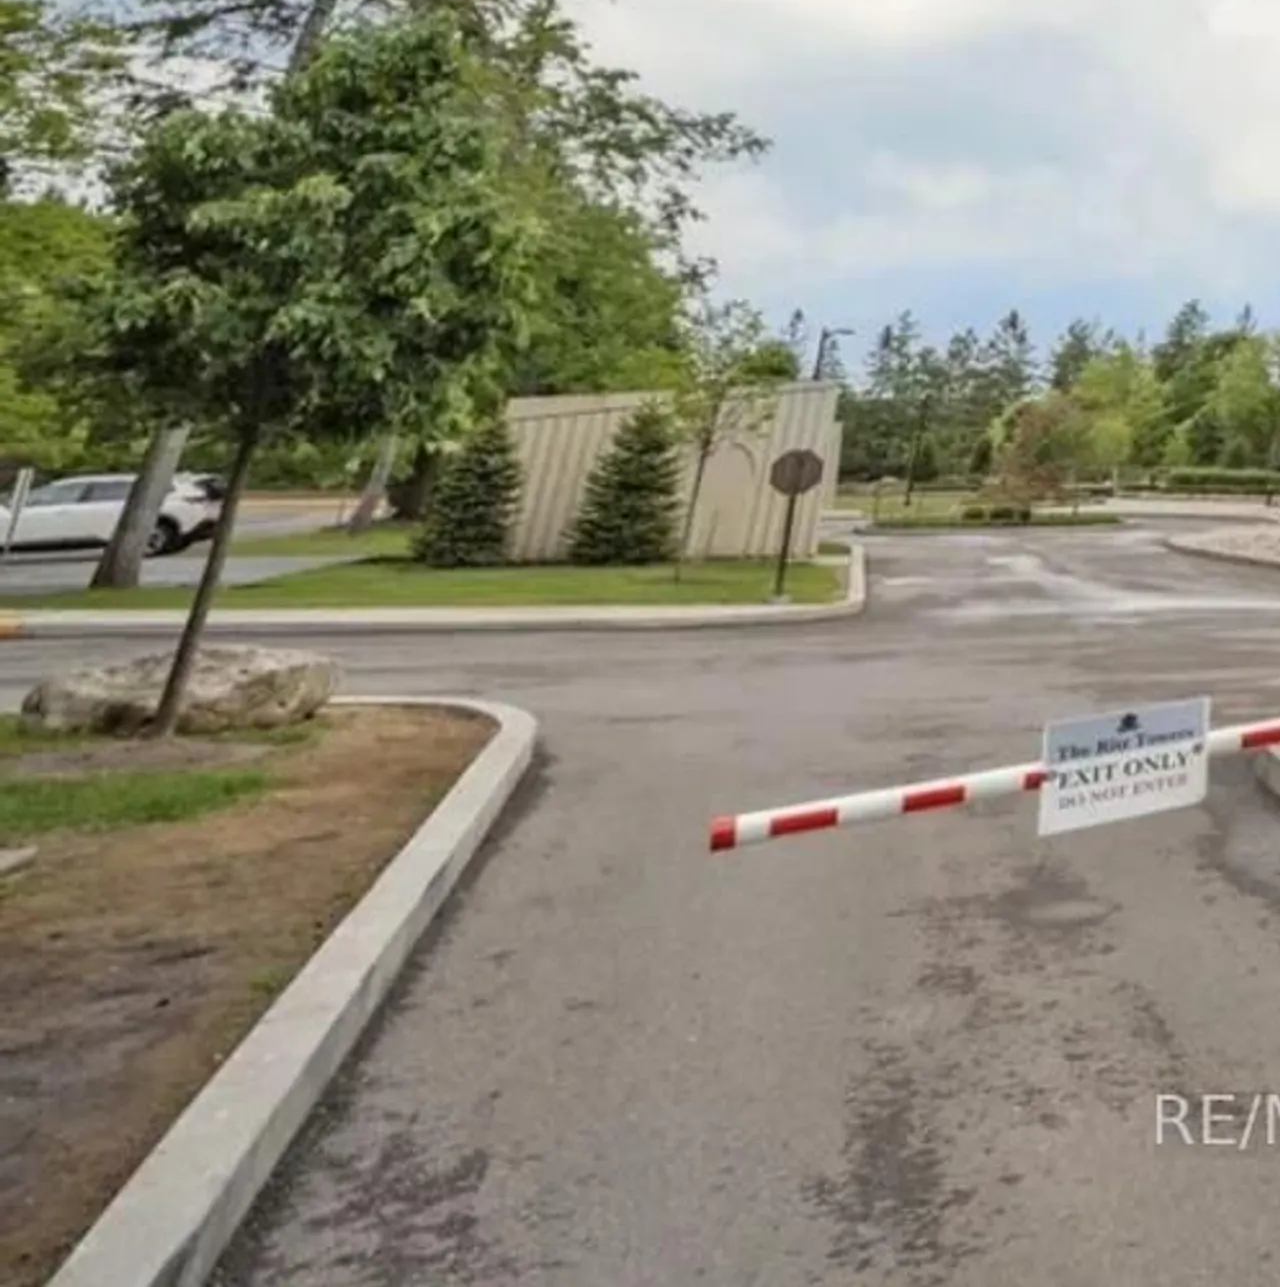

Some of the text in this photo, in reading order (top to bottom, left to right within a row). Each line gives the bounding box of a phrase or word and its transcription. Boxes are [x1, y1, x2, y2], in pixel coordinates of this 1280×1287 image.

[1058, 750, 1190, 790] EXIT ONLY
[1057, 772, 1188, 810] DO NOT ENTER
